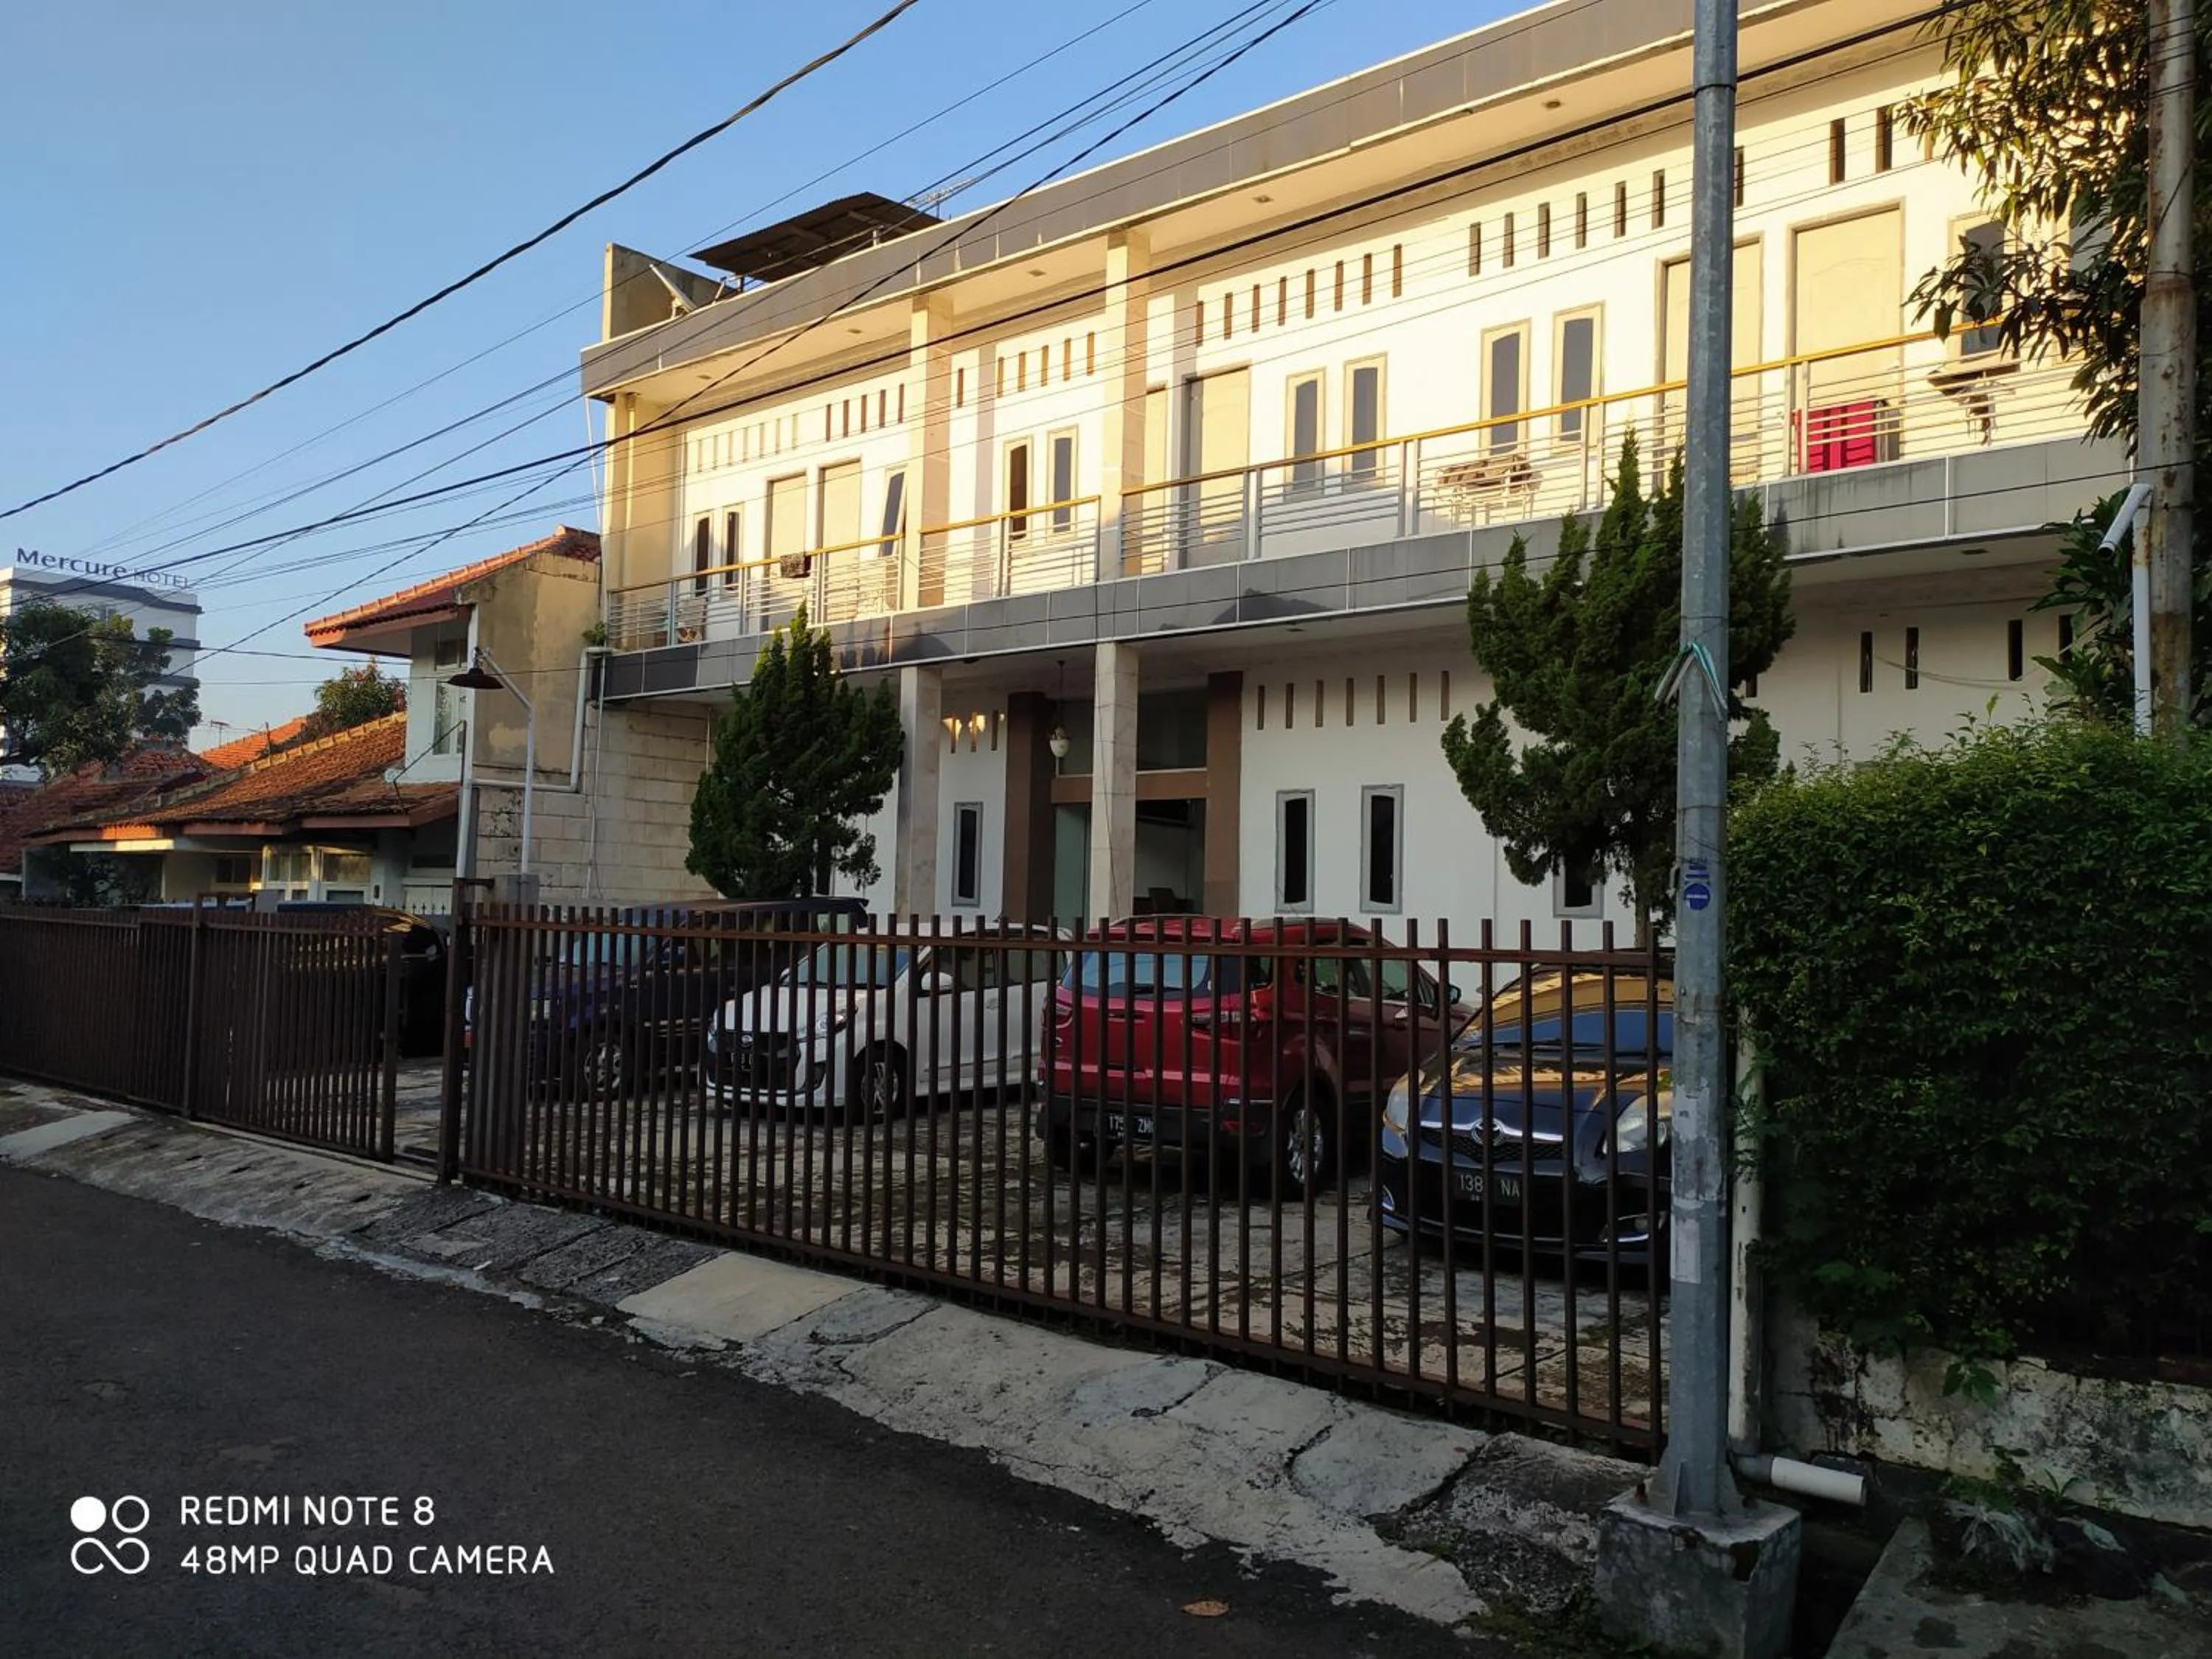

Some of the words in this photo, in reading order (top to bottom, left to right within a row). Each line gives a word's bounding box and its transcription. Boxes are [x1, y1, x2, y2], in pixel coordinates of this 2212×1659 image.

[17, 548, 127, 578] Mercure
[134, 568, 189, 588] HOTEL
[1460, 1174, 1485, 1192] 138
